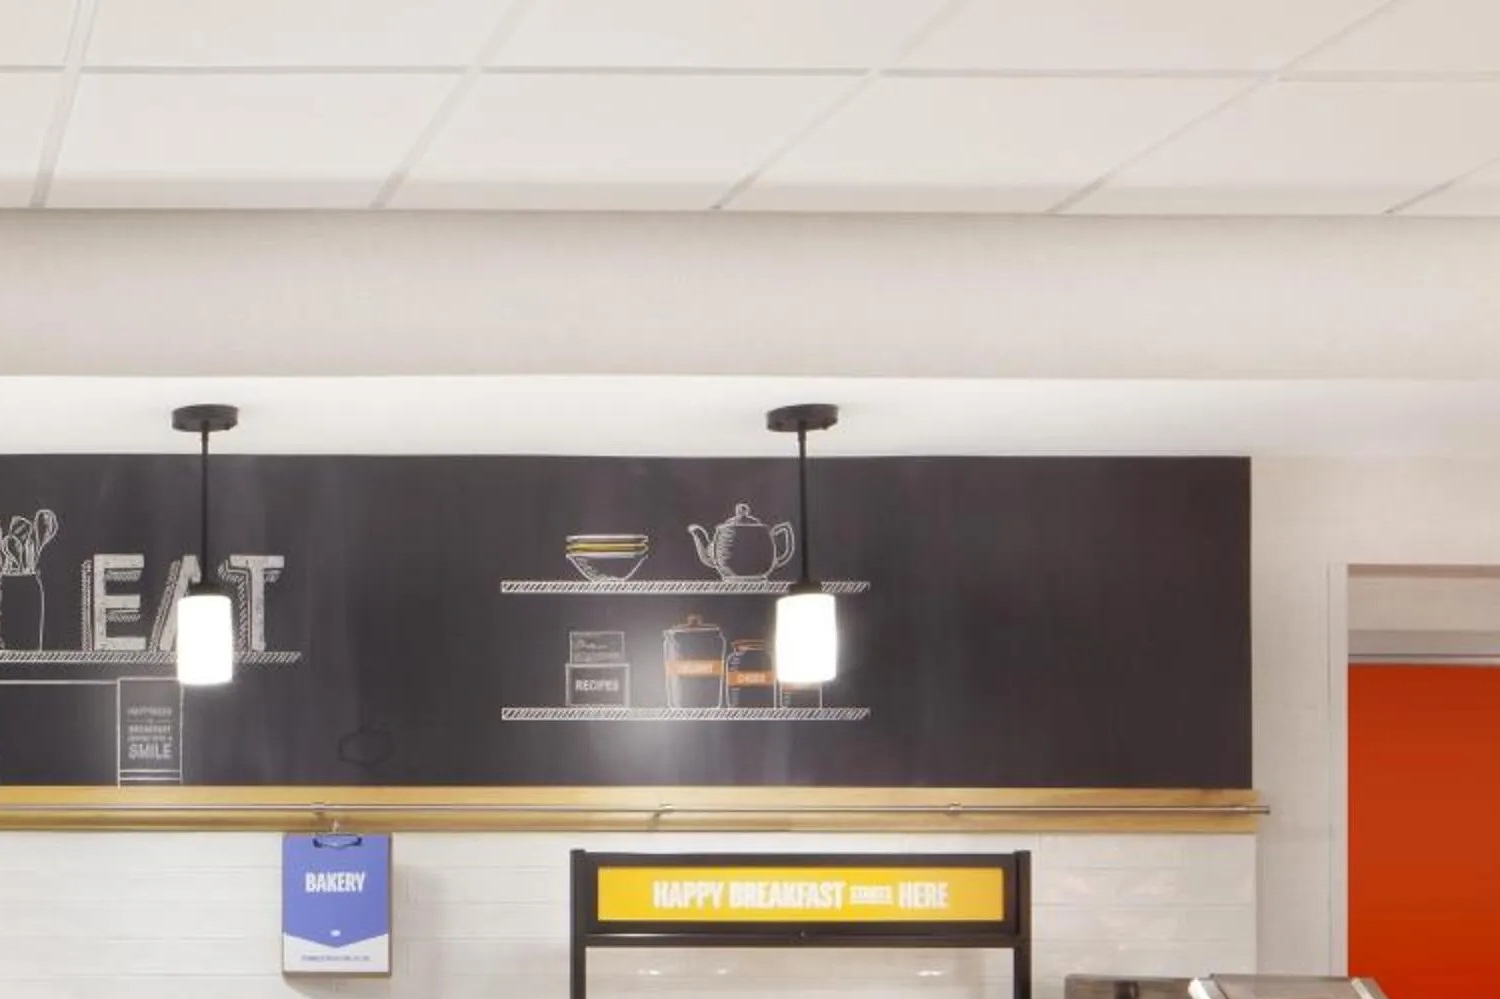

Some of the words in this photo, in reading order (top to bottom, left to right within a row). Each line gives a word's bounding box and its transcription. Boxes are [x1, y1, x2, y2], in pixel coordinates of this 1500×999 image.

[574, 679, 619, 692] RECIPES
[128, 743, 173, 760] SMILE
[305, 871, 365, 893] BAKERY
[652, 881, 725, 908] HAPPY
[729, 881, 846, 908] BREAKFAST
[899, 881, 948, 908] HERE
